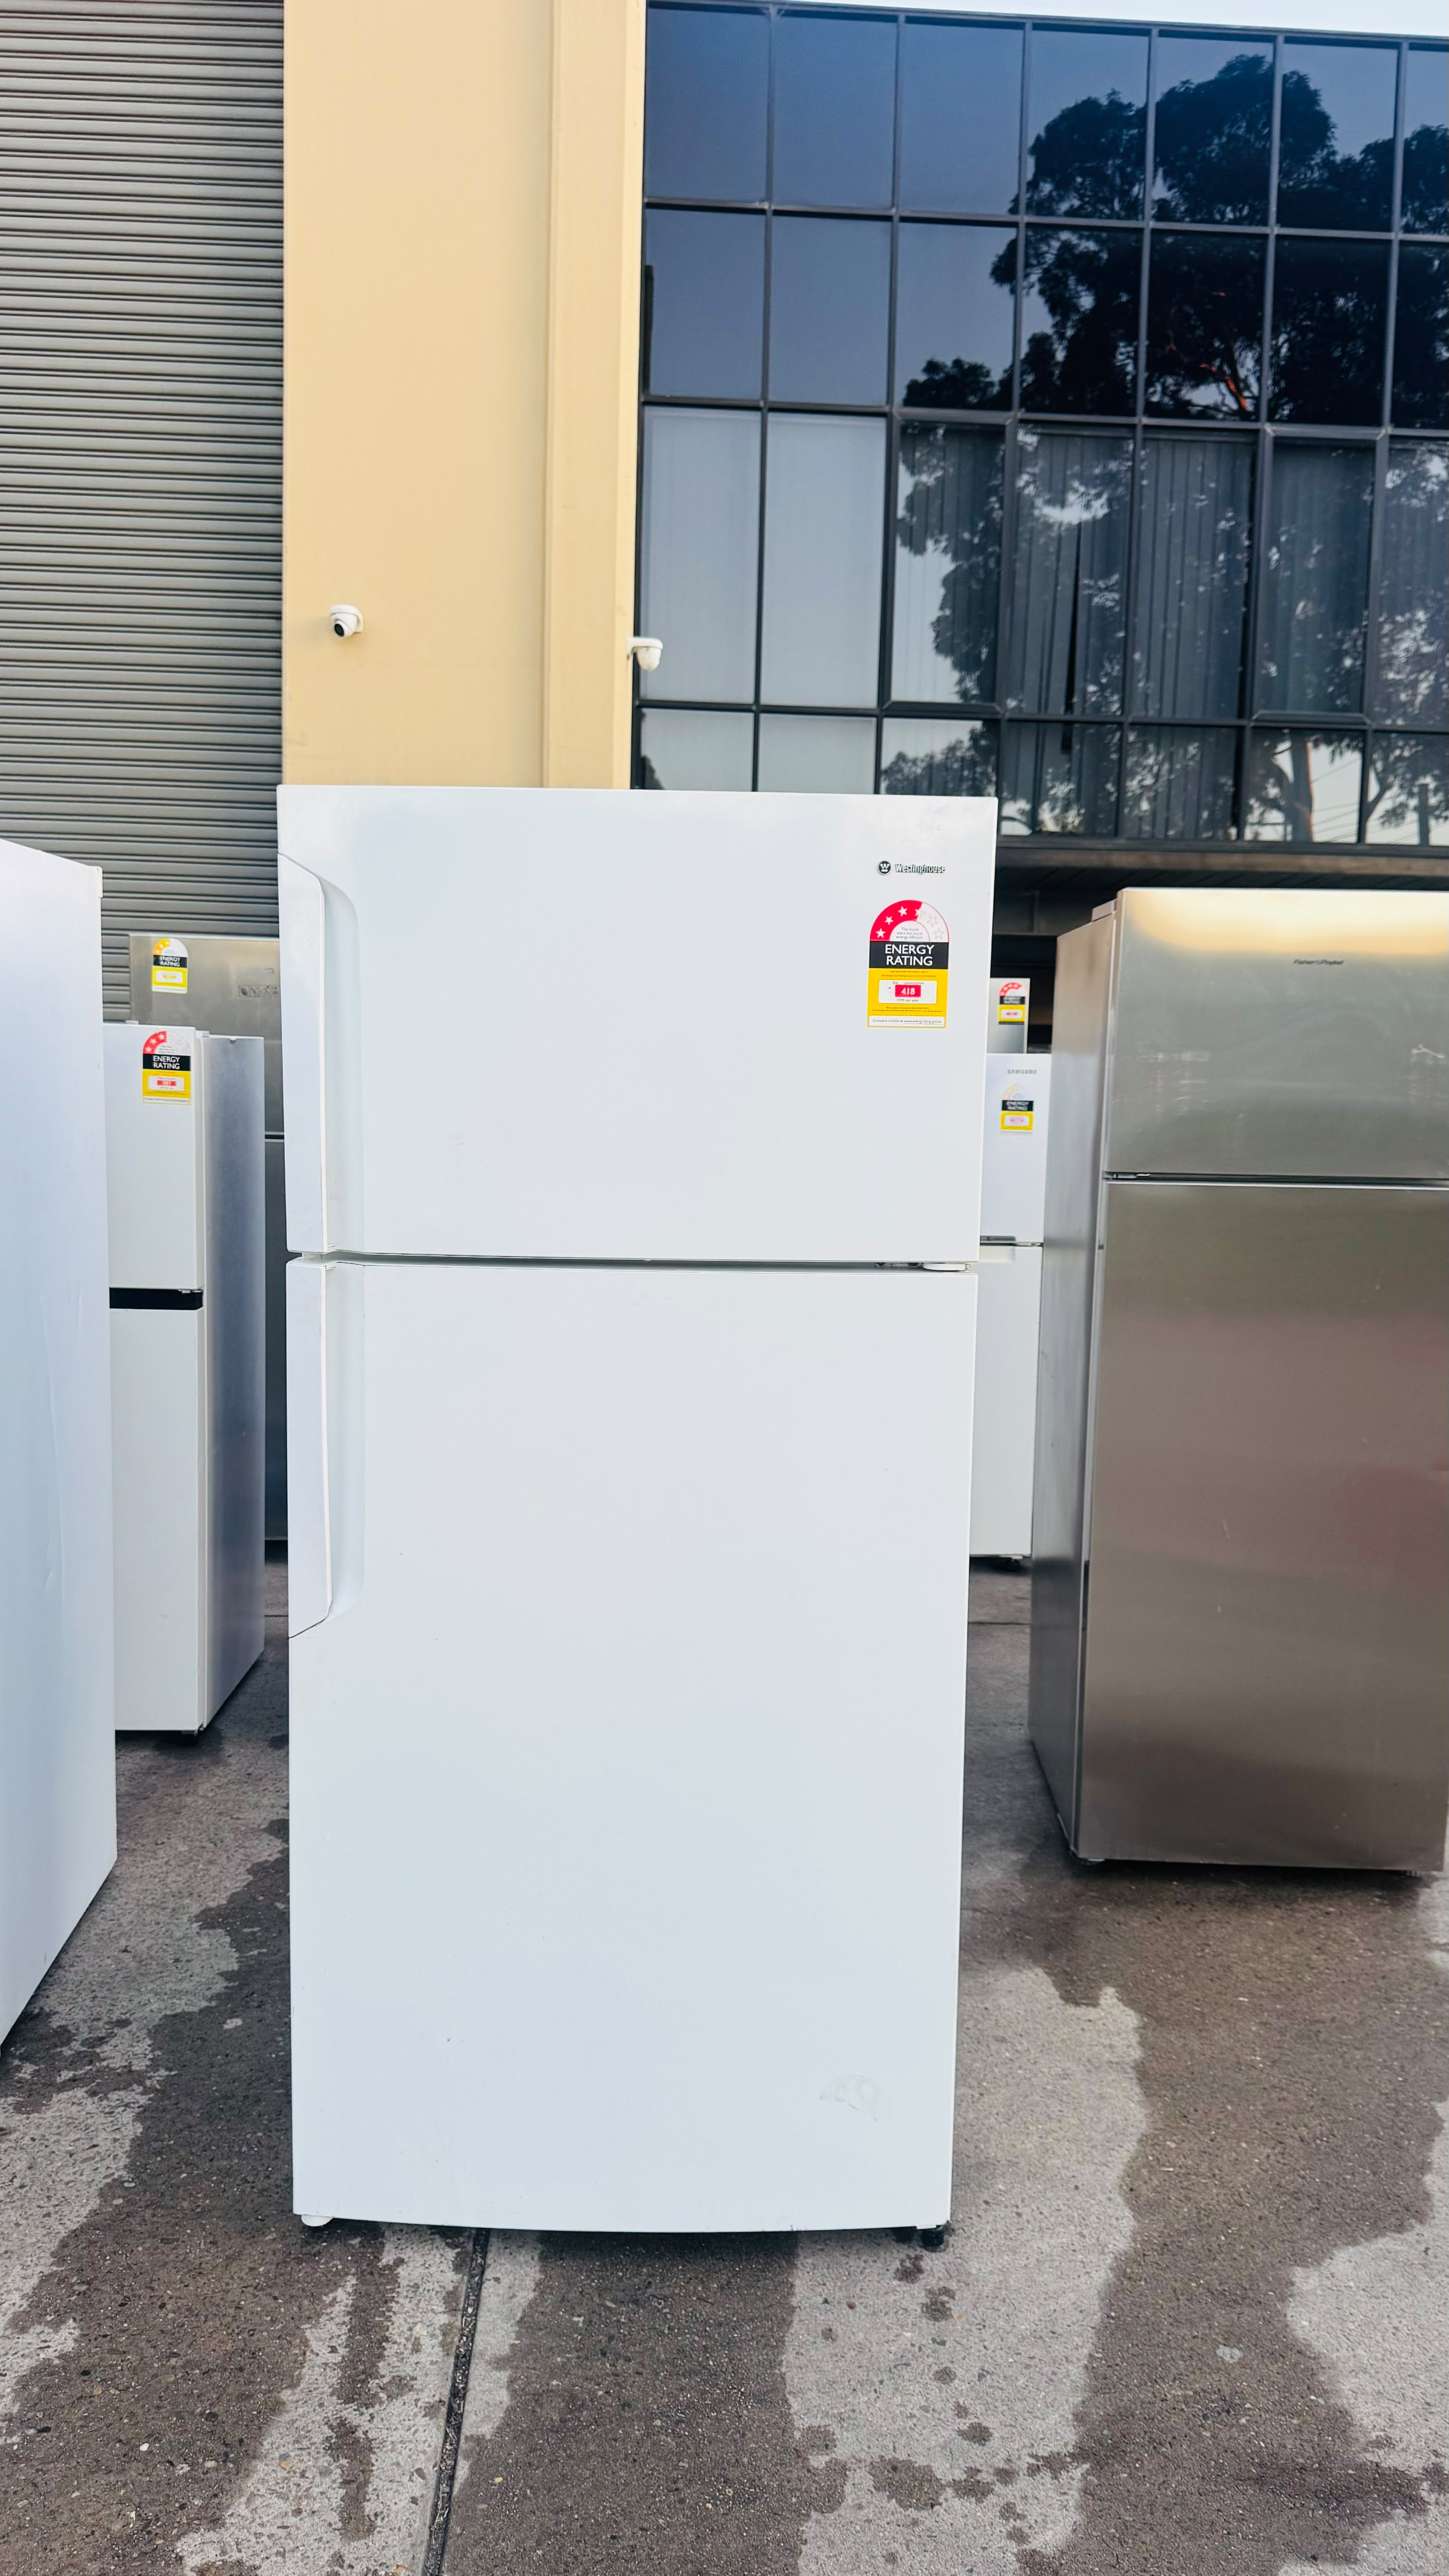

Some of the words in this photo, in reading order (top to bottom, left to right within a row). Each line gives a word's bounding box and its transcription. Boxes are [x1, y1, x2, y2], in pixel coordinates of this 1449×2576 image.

[895, 864, 946, 874] Westinghouse
[885, 944, 935, 954] ENERGY
[886, 955, 933, 966] RATING
